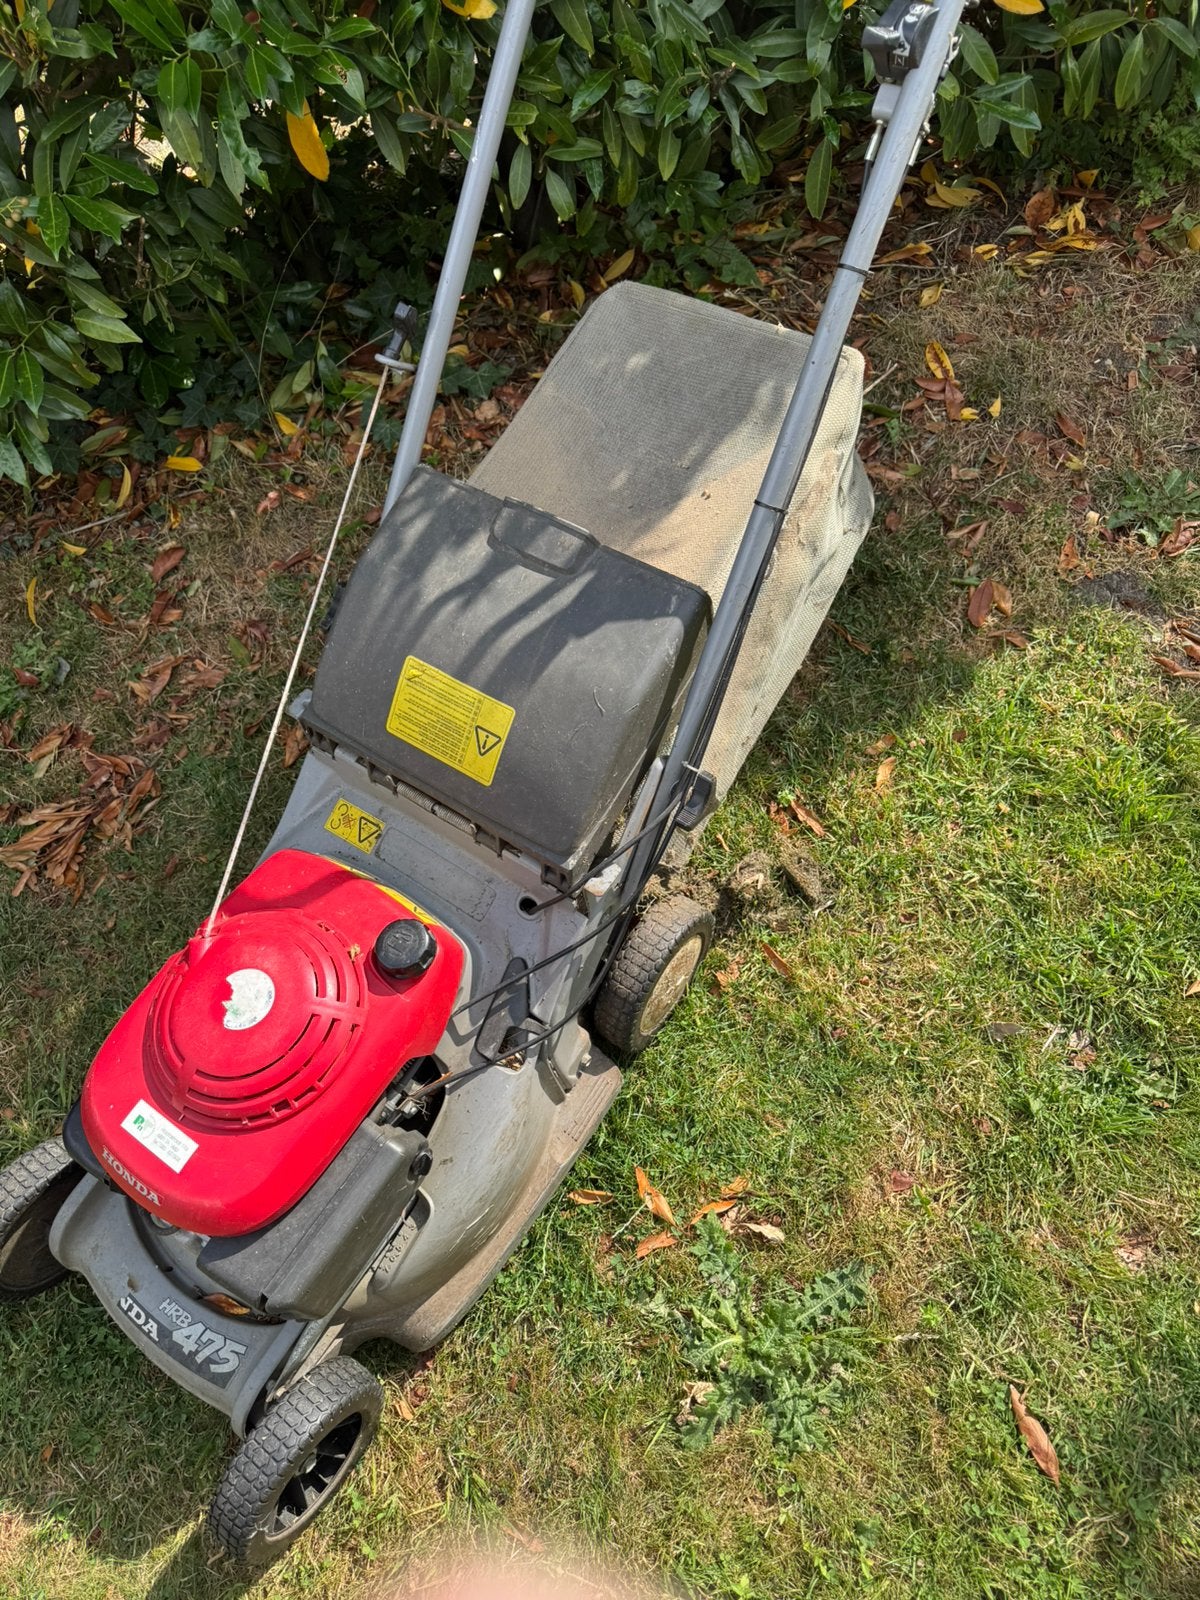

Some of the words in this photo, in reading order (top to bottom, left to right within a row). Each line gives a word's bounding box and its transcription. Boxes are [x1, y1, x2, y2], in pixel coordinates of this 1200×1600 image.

[102, 1149, 161, 1206] HONDA
[158, 1298, 192, 1328] HRB
[172, 1321, 248, 1374] 475
